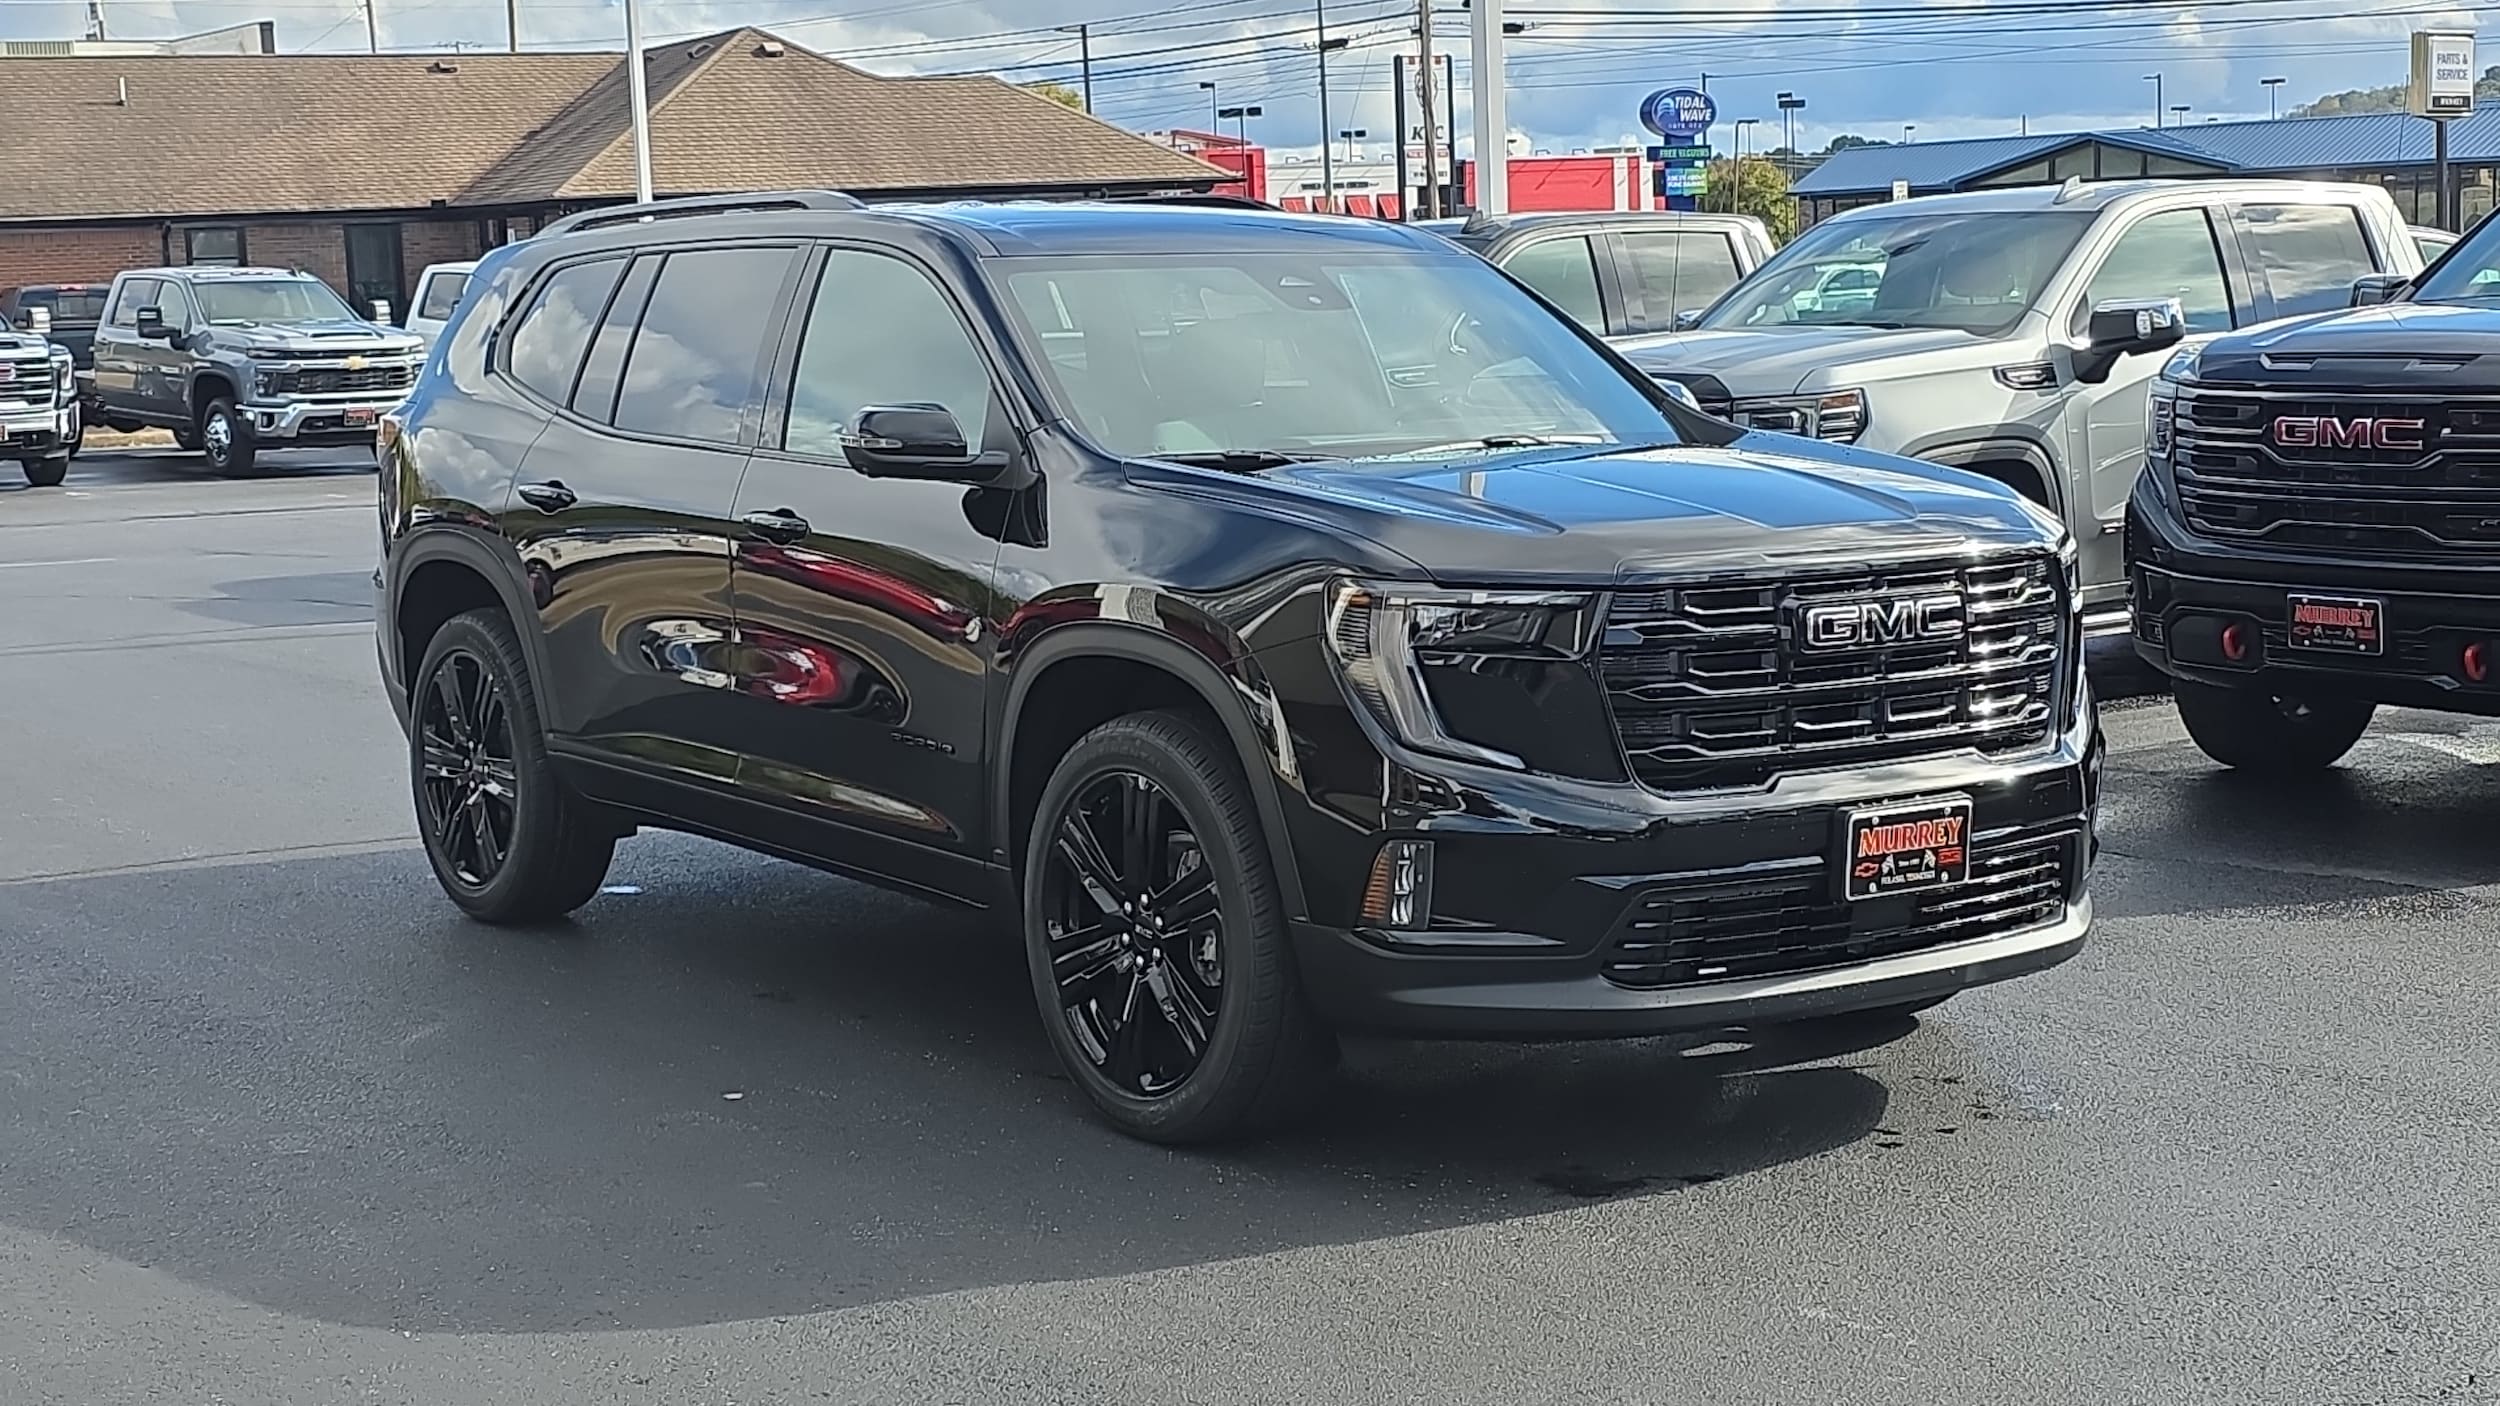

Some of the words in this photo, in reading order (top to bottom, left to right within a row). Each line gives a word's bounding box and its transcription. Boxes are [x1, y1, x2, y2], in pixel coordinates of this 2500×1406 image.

[2436, 53, 2460, 64] PARTS
[2462, 53, 2468, 64] &
[2436, 69, 2468, 80] SERVICE
[1675, 96, 1705, 108] TIDAL
[1680, 109, 1712, 121] WAVE
[1411, 126, 1444, 140] KC
[2274, 416, 2425, 450] GMC
[1806, 596, 1964, 647] GMC
[2294, 604, 2375, 628] MURREY
[1857, 816, 1964, 858] MURREY
